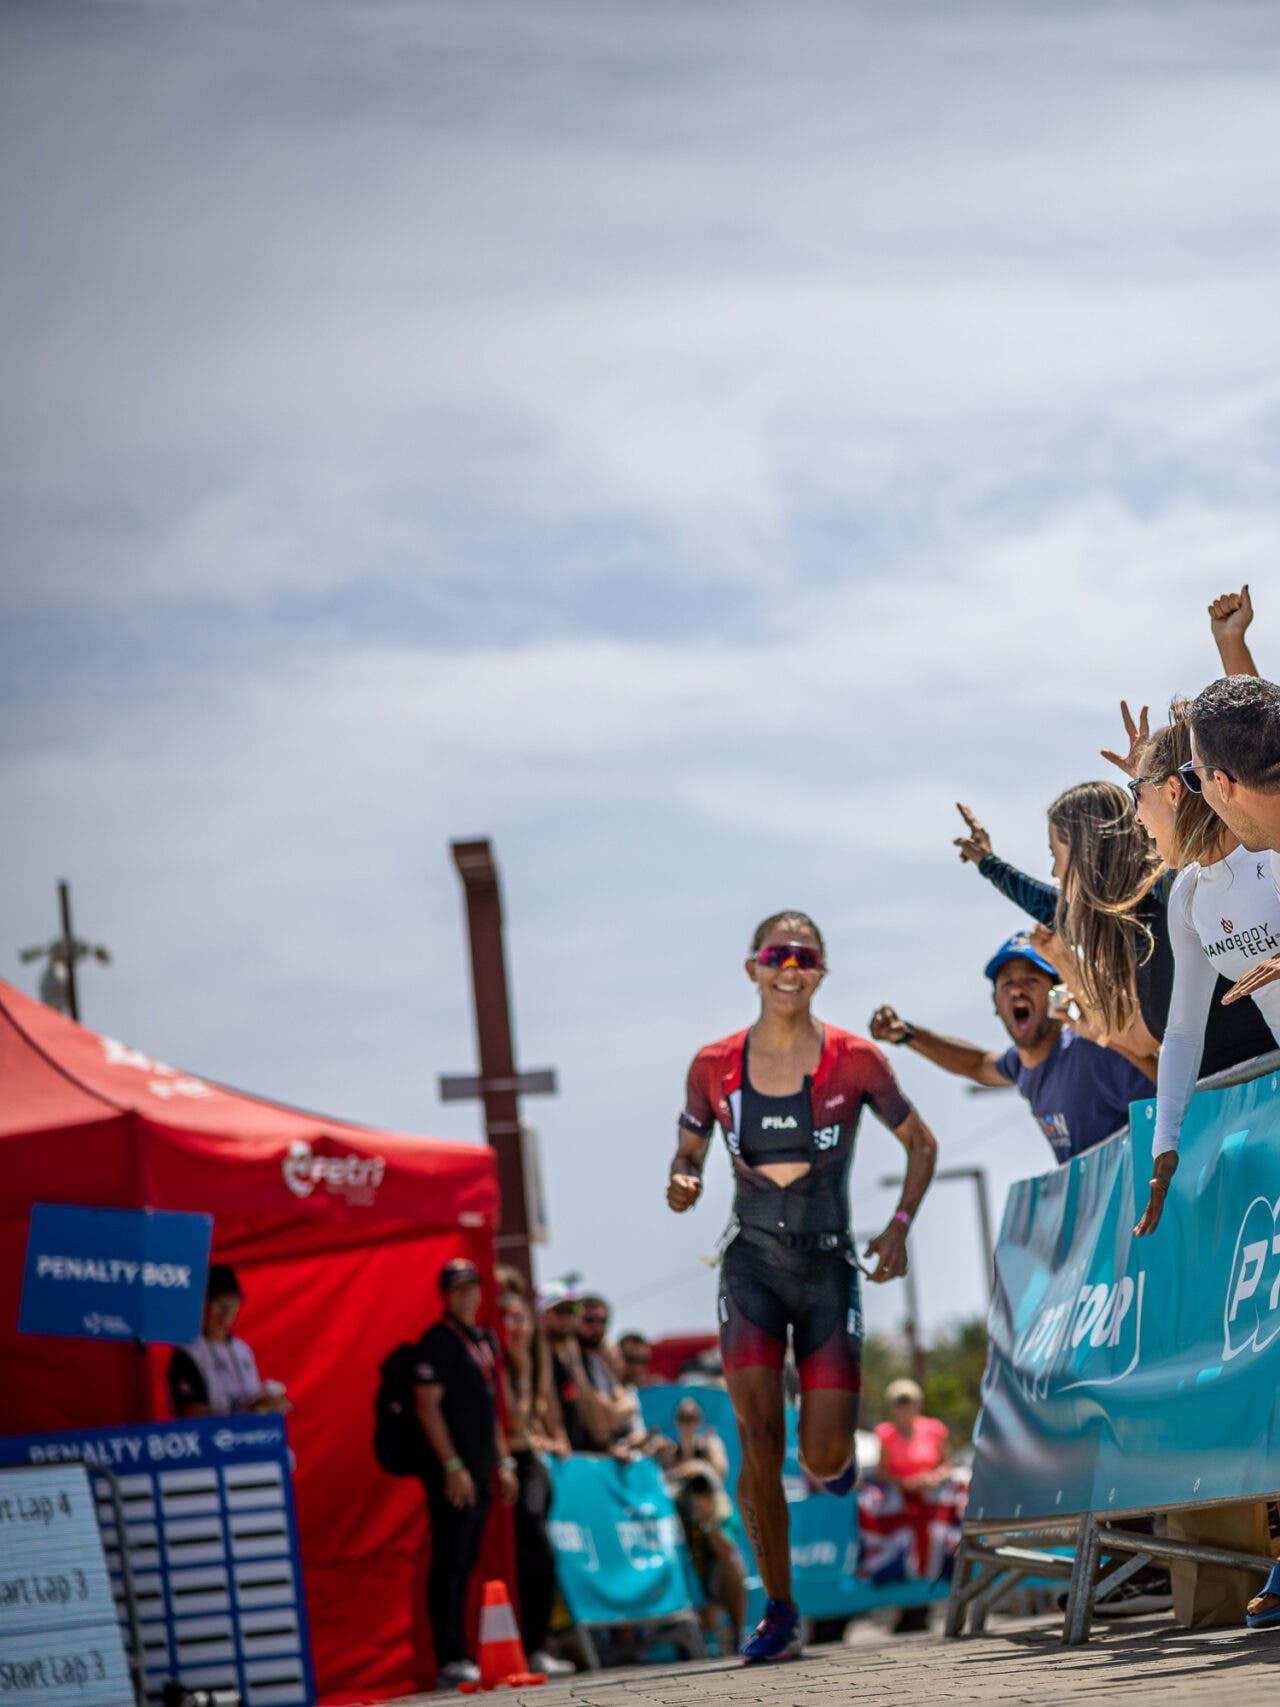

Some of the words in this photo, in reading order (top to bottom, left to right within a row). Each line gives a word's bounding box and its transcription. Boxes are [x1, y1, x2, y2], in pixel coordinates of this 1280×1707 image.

[761, 1116, 798, 1130] FILA
[36, 1254, 139, 1285] PENALTY
[141, 1261, 192, 1289] BOX
[29, 1434, 143, 1465] PENALTY
[147, 1430, 202, 1461] BOX
